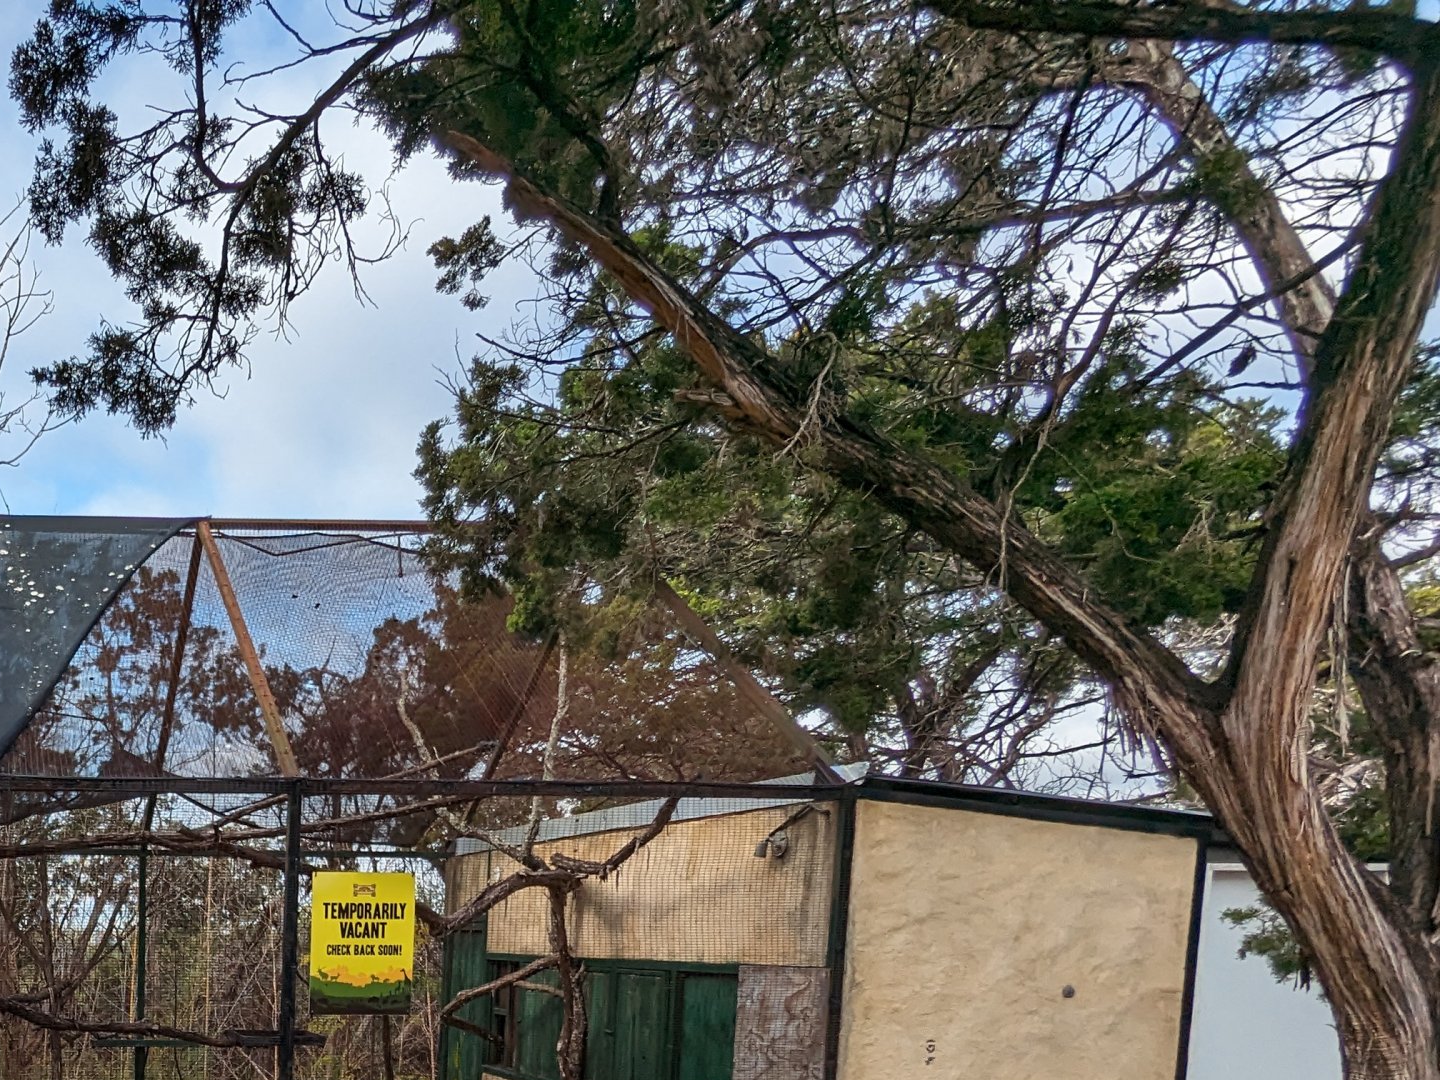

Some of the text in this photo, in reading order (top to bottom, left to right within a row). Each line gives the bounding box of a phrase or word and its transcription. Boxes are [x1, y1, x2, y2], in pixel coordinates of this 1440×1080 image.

[323, 903, 406, 919] TEMPORARILY
[340, 922, 387, 939] VACANT
[326, 944, 402, 956] CHECK BACK SOON!
